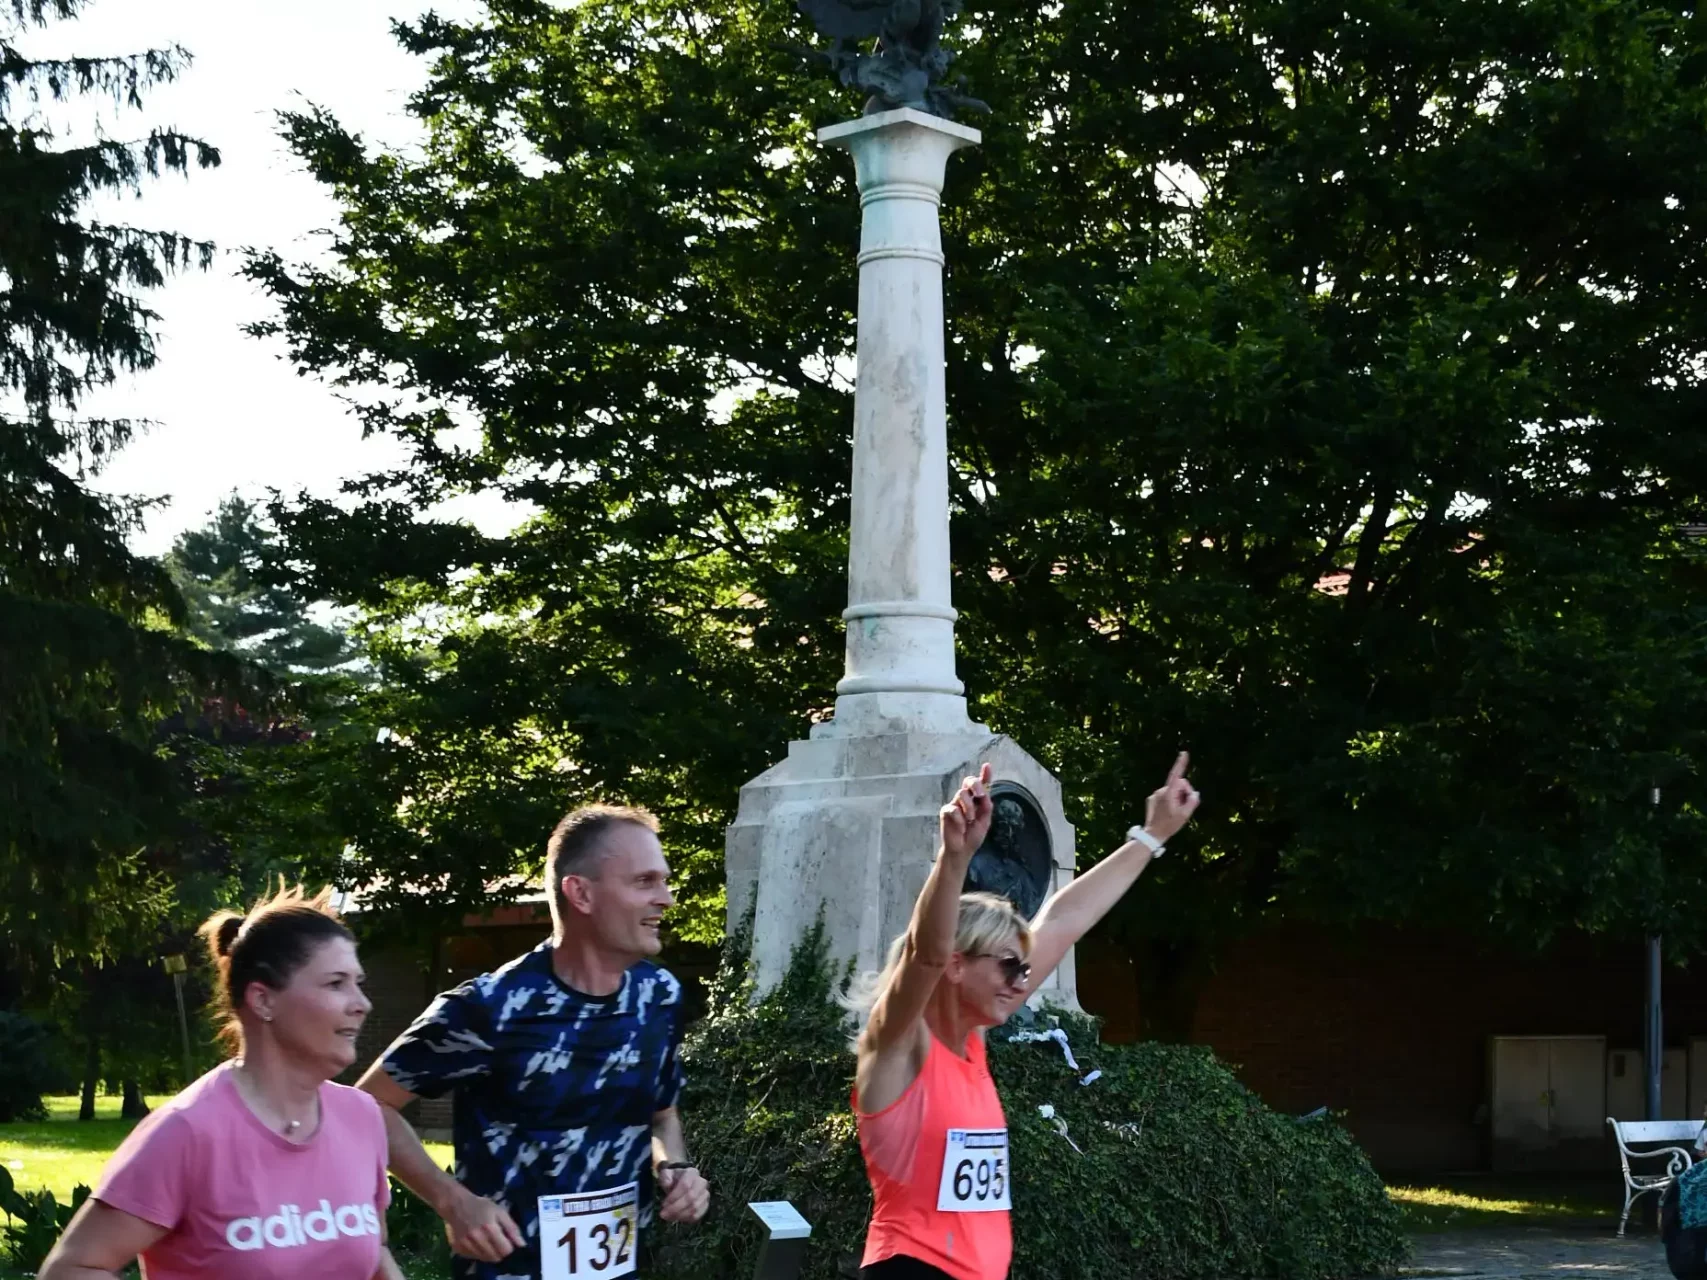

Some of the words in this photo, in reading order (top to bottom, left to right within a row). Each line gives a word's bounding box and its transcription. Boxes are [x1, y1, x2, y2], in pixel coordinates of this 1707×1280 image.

[953, 1158, 1004, 1201] 695
[226, 1199, 380, 1250] adidas
[557, 1217, 631, 1274] 132
